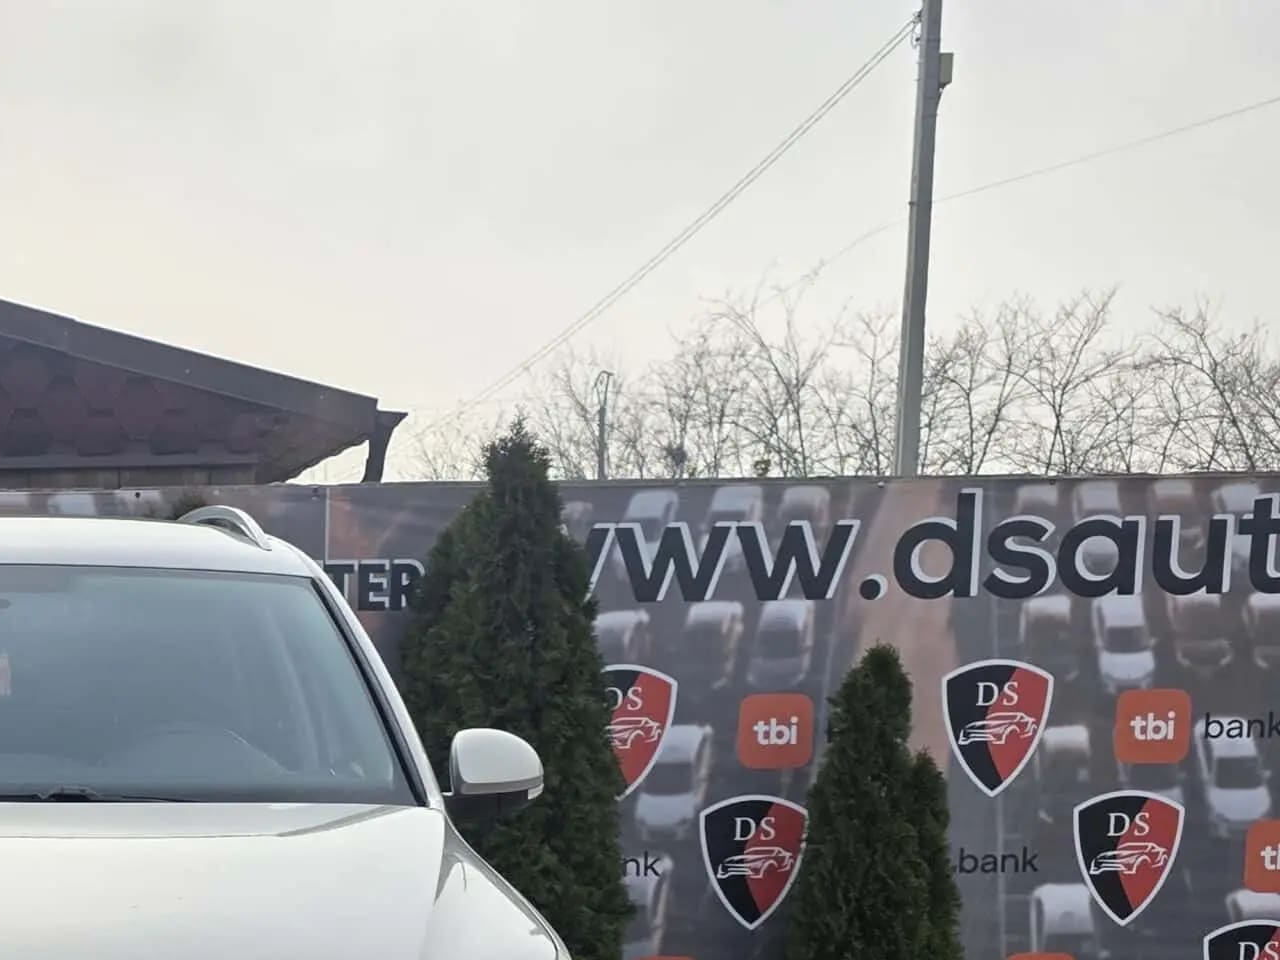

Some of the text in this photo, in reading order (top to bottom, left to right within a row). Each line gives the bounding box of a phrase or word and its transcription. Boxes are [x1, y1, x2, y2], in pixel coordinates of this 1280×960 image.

[975, 681, 1019, 707] DS
[753, 716, 799, 745] tbi
[1130, 711, 1176, 741] tbi
[733, 816, 777, 841] DS
[1107, 811, 1150, 837] DS
[958, 846, 1039, 874] bank
